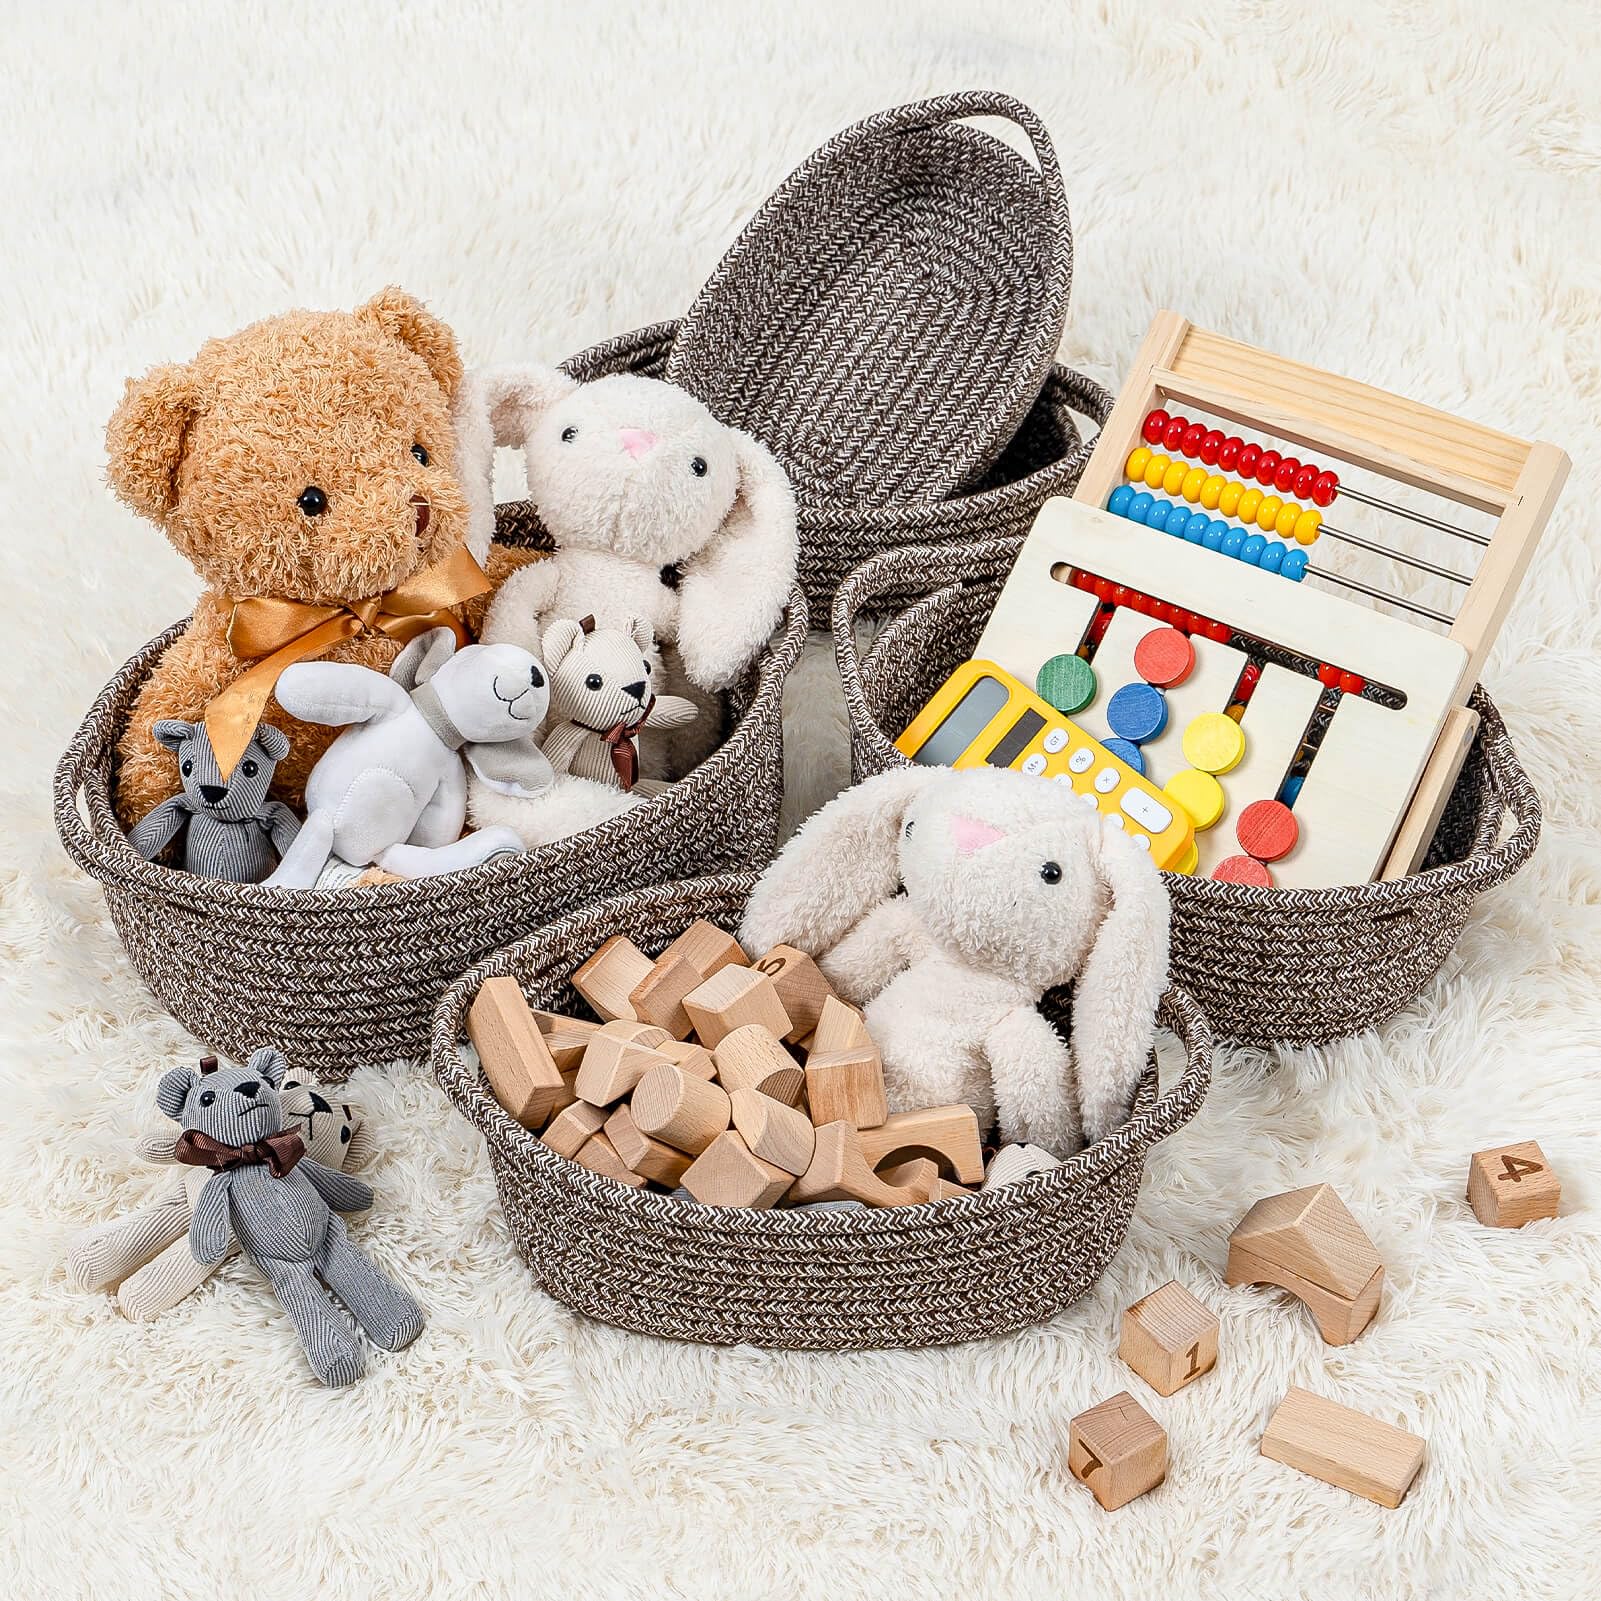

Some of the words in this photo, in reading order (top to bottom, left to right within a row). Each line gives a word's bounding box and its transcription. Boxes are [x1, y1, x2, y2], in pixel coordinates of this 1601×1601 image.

[1498, 1155, 1544, 1183] 4
[1183, 1341, 1201, 1381] 1
[1078, 1438, 1104, 1480] 7
